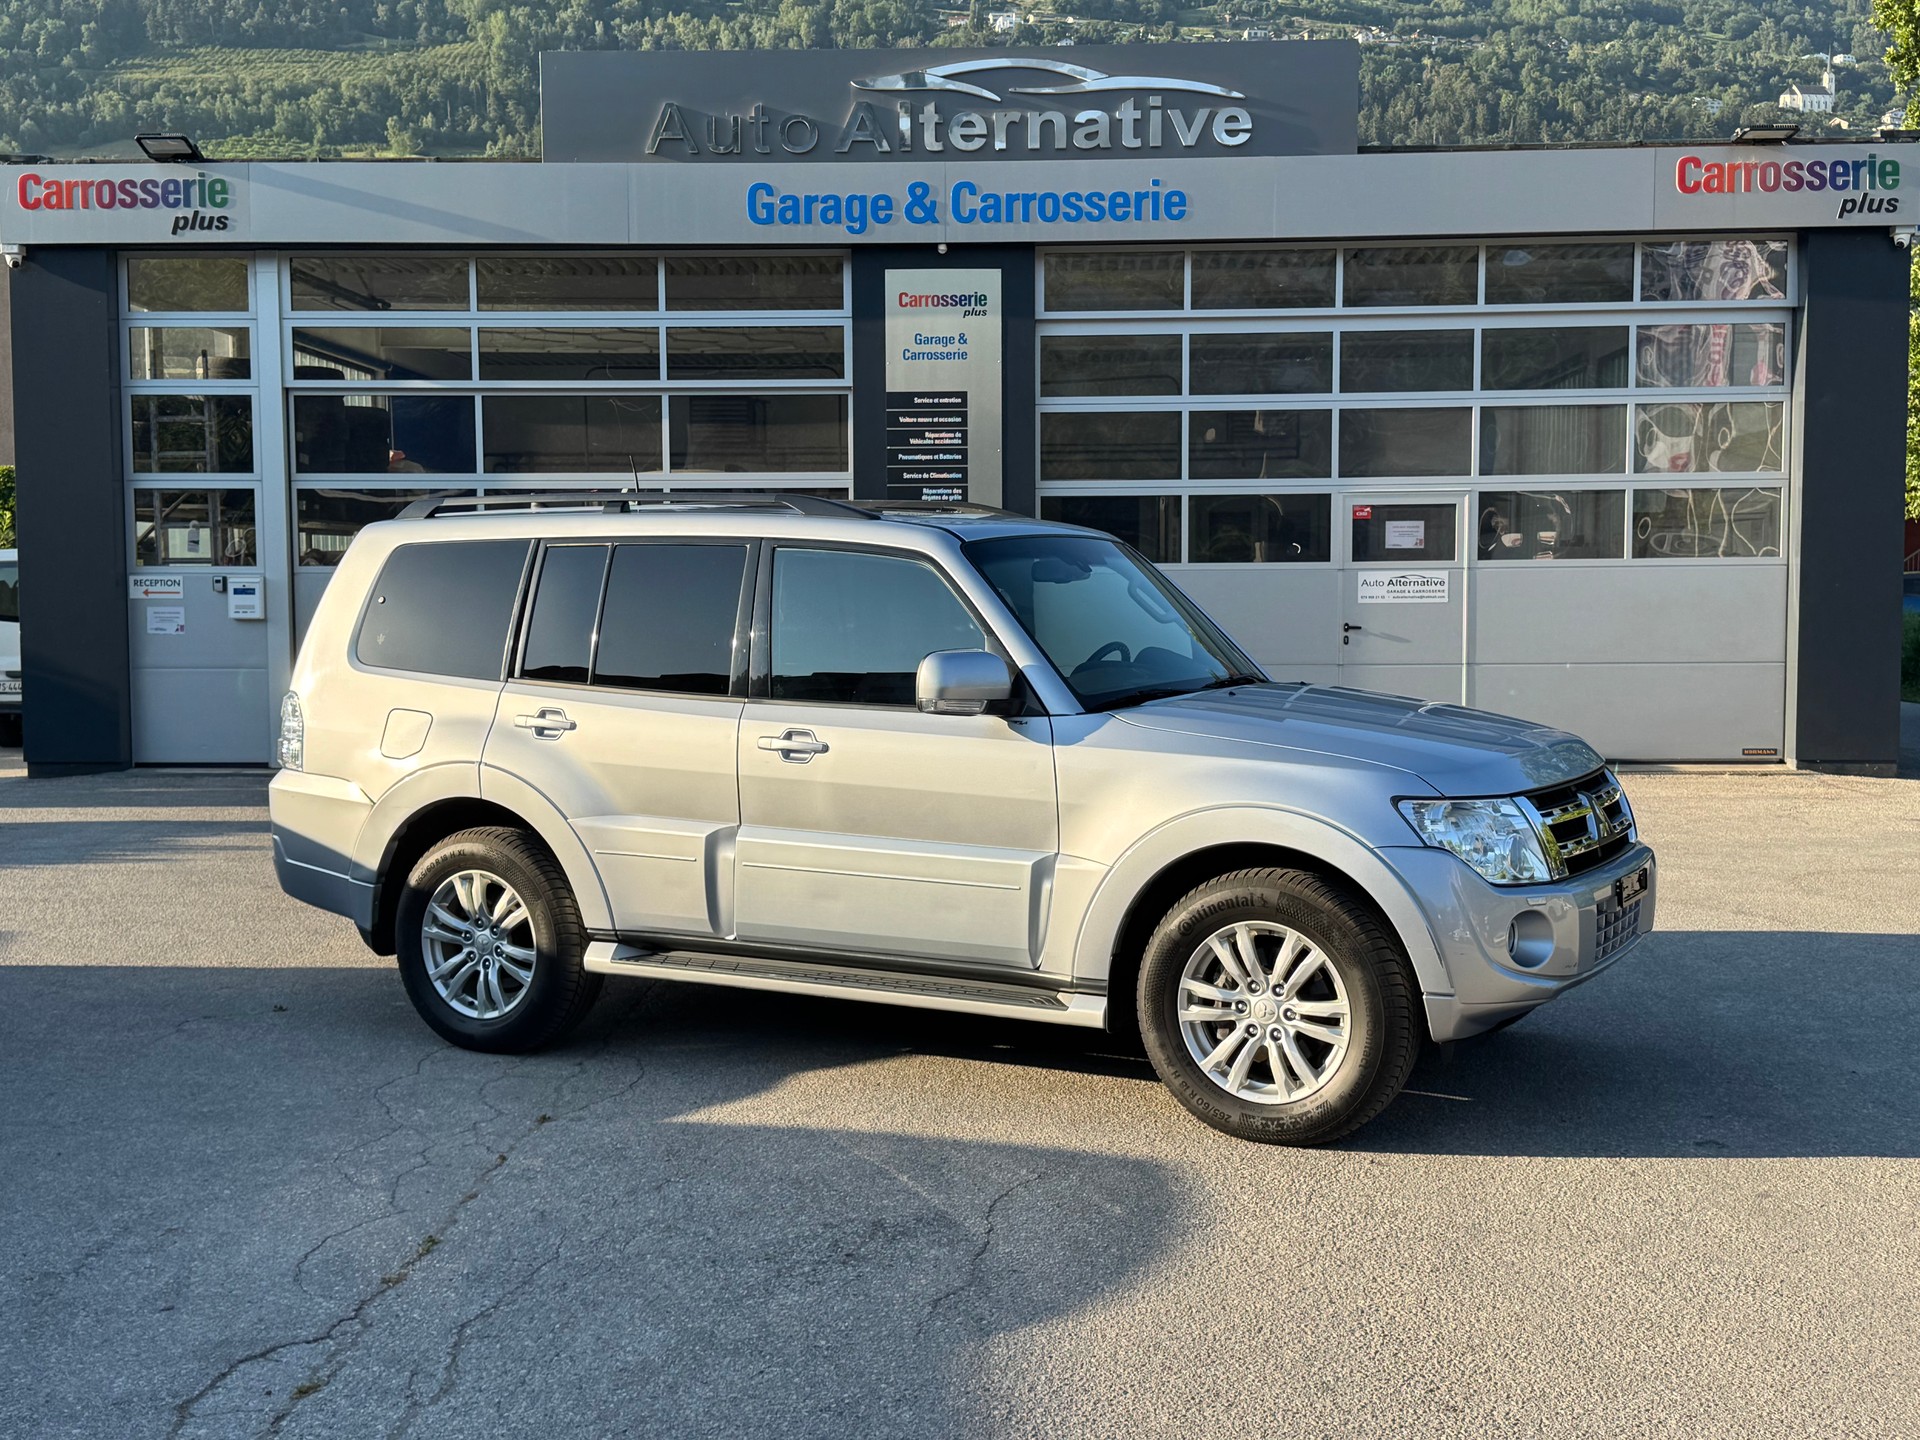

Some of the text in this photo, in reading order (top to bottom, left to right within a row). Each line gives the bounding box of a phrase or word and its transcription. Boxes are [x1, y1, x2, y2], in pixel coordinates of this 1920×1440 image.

[646, 95, 1253, 154] Auto Alternative
[1675, 153, 1900, 194] Carrosserie
[17, 172, 229, 211] Carrosserie
[747, 179, 1187, 235] Garage & Carrosserie
[1836, 192, 1899, 219] plus
[171, 210, 229, 235] plus
[898, 291, 988, 308] Carrosserie
[963, 307, 988, 318] plus
[914, 332, 968, 348] Garage &
[902, 348, 968, 361] Carrosserie
[898, 453, 933, 461] Pneumatiques
[133, 579, 181, 588] RECEPTION
[1361, 578, 1446, 587] Auto Alternative
[1178, 892, 1256, 937] Continental
[1188, 1089, 1197, 1100] R
[1196, 1097, 1232, 1123] 265/60
